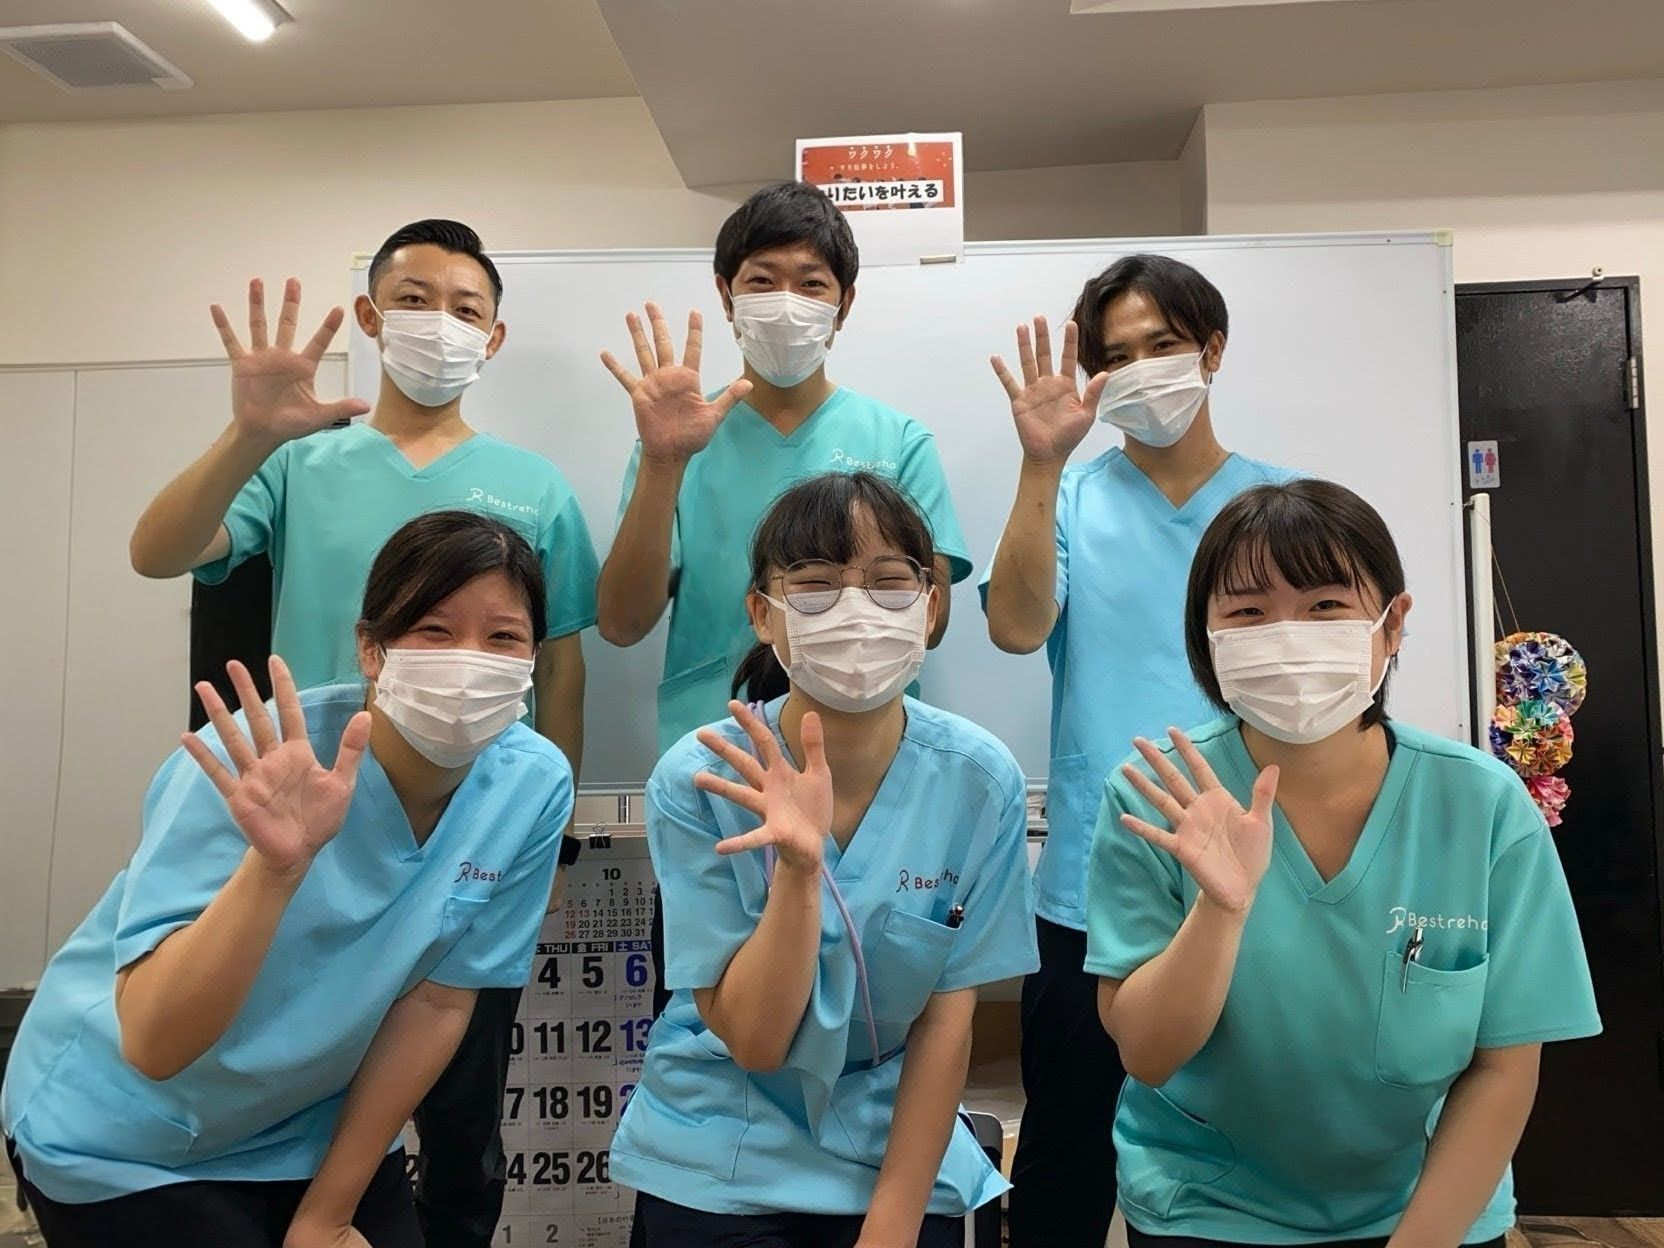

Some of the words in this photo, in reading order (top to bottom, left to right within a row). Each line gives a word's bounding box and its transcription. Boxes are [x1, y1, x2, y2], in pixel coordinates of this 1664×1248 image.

[848, 147, 893, 160] ワクワク
[602, 868, 621, 880] 10
[623, 888, 629, 896] 2
[568, 900, 573, 908] 5
[623, 898, 629, 906] 9
[579, 910, 590, 918] 13
[593, 909, 604, 917] 14
[565, 921, 576, 929] 19
[579, 920, 590, 928] 20
[592, 920, 603, 928] 21
[606, 920, 618, 928] 22
[621, 919, 632, 927] 23
[565, 931, 576, 939] 26
[579, 931, 590, 939] 27
[592, 930, 604, 938] 28
[621, 929, 632, 937] 30
[635, 929, 645, 937] 31
[544, 944, 568, 953] THU
[577, 943, 587, 953] 金
[591, 942, 609, 951] FRI
[618, 942, 629, 952] 土
[538, 957, 561, 989] 4
[582, 956, 604, 989] 5
[625, 954, 648, 987] 6
[534, 1022, 565, 1054] 11
[576, 1020, 612, 1053] 12
[620, 1018, 653, 1052] 13
[501, 1087, 525, 1120] 7
[533, 1086, 569, 1119] 18
[577, 1085, 613, 1119] 19
[532, 1151, 571, 1185] 25
[576, 1151, 612, 1184] 26
[502, 1225, 512, 1243] 1
[546, 1224, 558, 1243] 2
